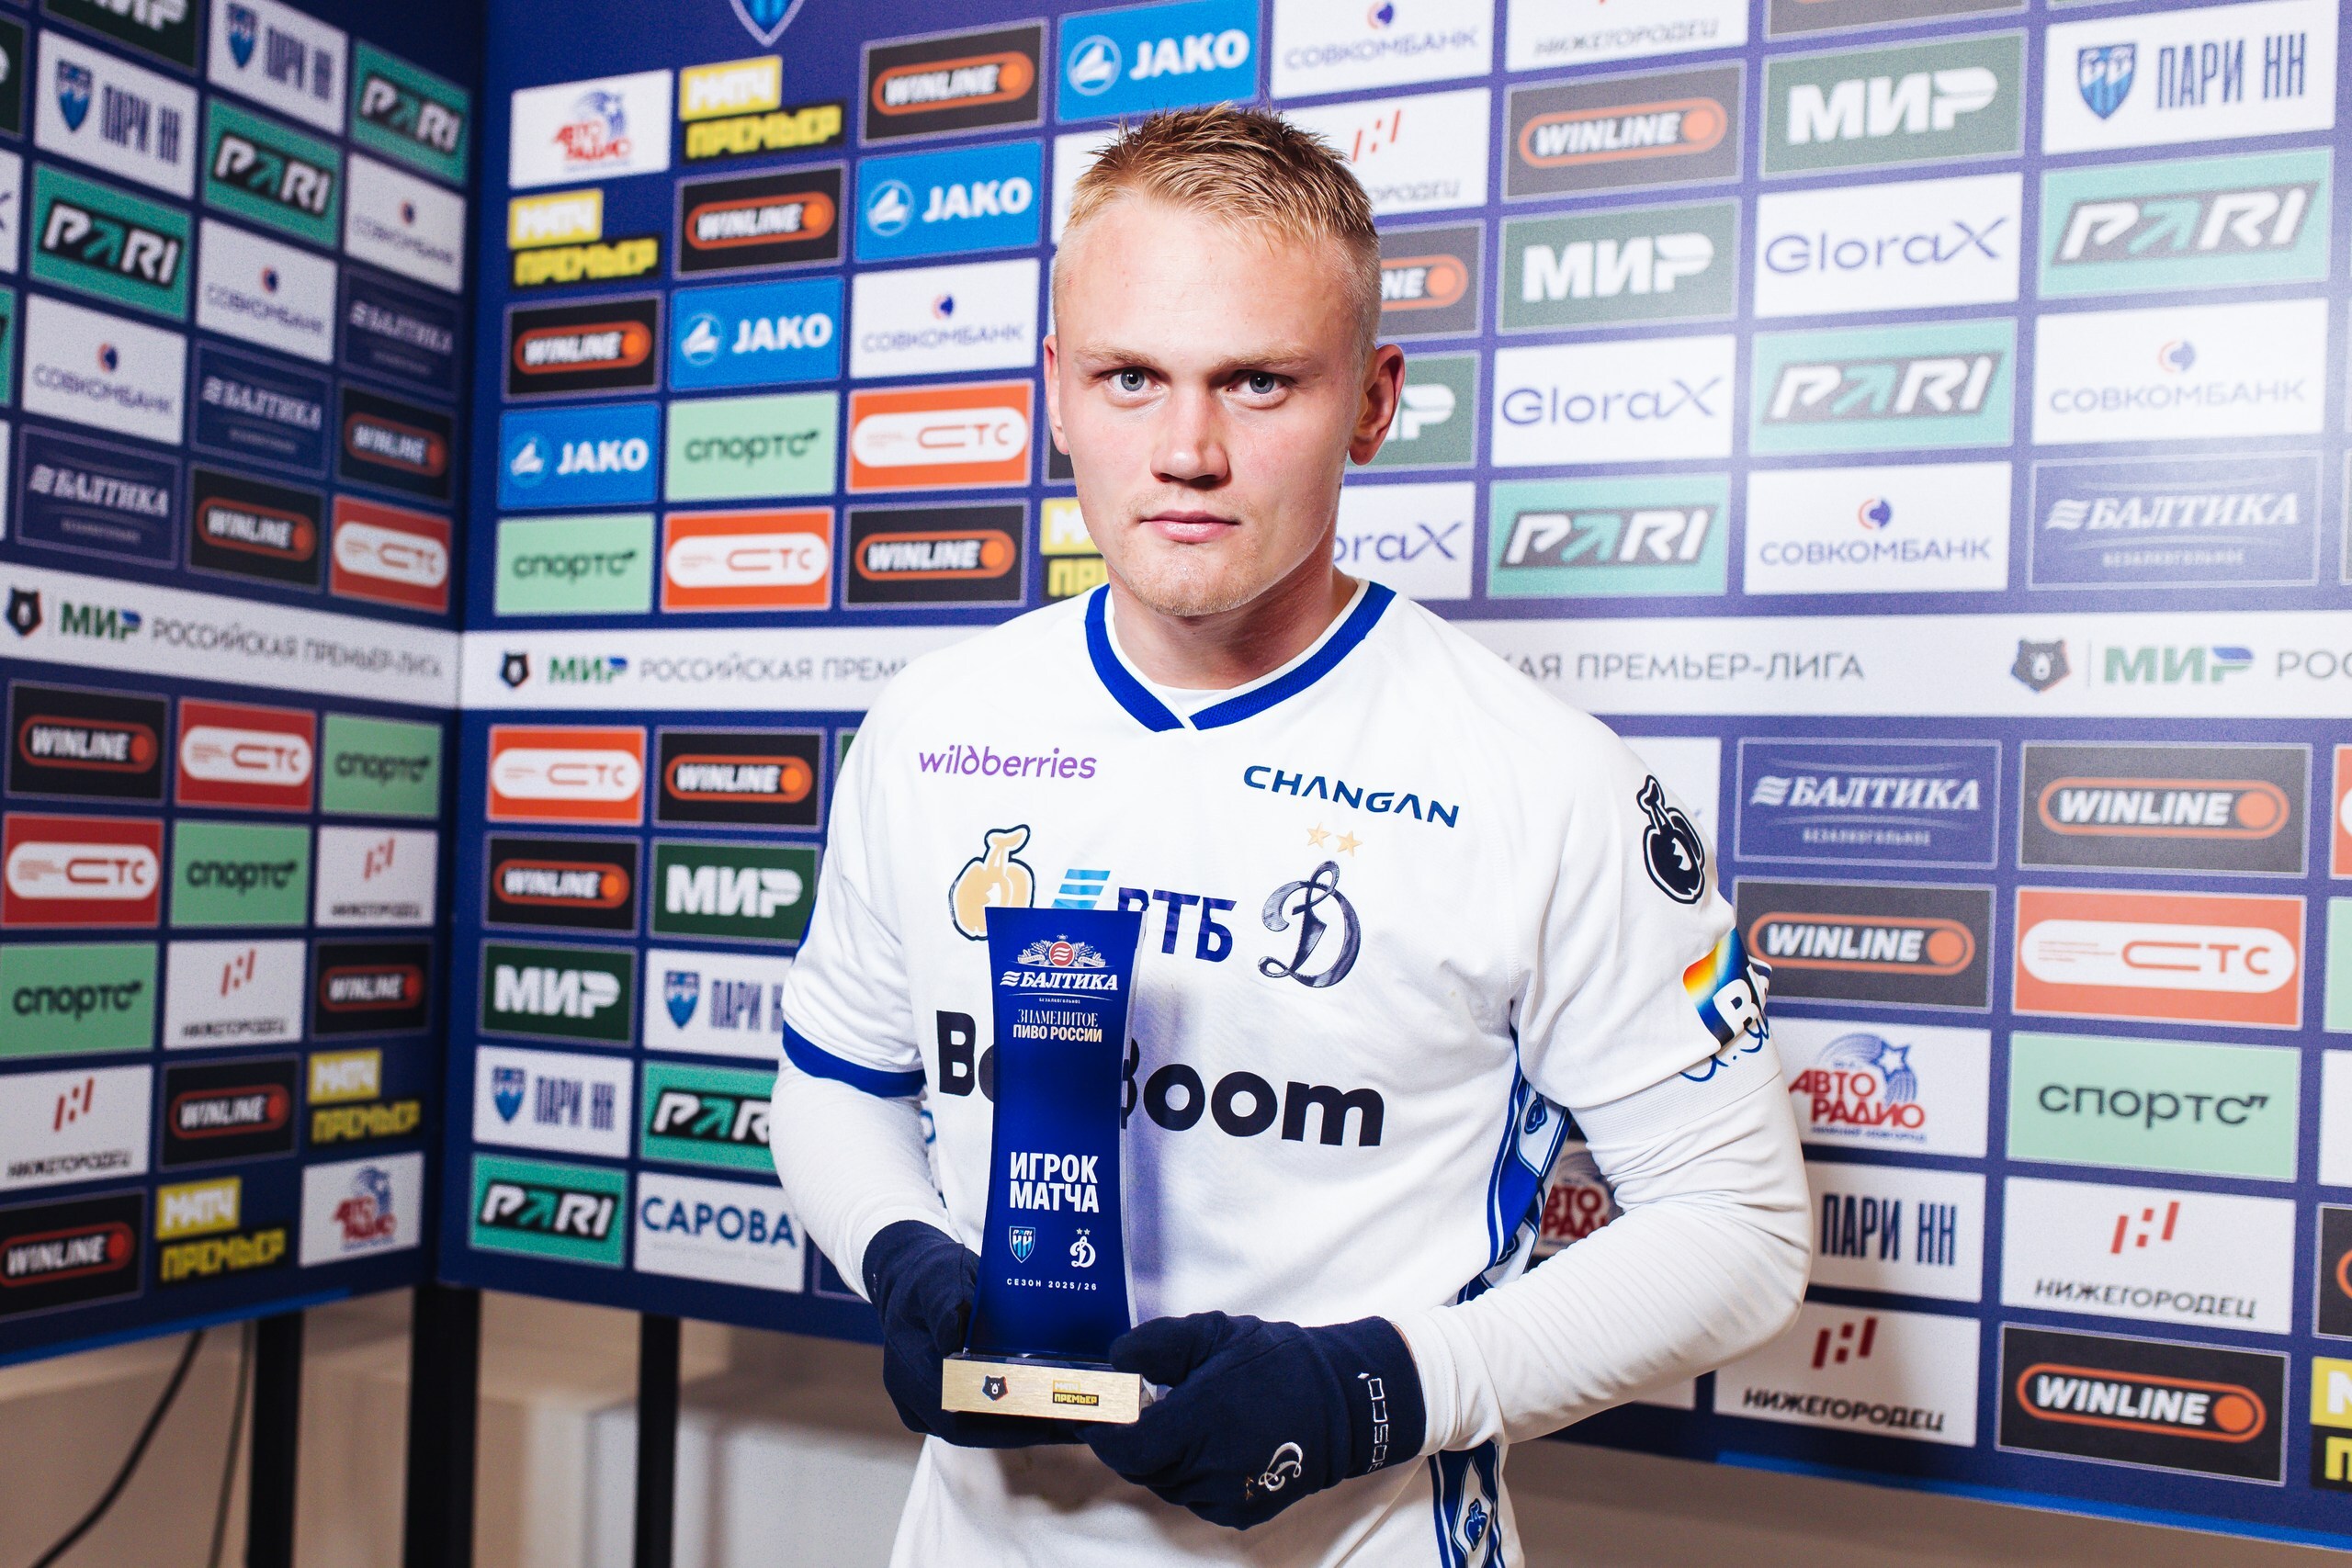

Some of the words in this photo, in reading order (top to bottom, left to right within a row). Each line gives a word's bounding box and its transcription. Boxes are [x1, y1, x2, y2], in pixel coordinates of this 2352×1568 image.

[1129, 30, 1250, 81] JAKO
[1285, 30, 1478, 71] СОВКОМБАНК
[2157, 39, 2244, 109] ПАРИ
[2264, 31, 2306, 100] НН
[1789, 67, 1998, 144] МИР
[1535, 112, 1680, 157] WINLINE
[215, 134, 332, 215] PARI
[922, 177, 1033, 222] JAKO
[698, 203, 803, 241] WINLINE
[2061, 188, 2306, 259] PARI
[42, 202, 180, 286] PARI
[1765, 217, 2008, 274] GloraX
[1523, 232, 1713, 302] МИР
[732, 312, 832, 351] JAKO
[1501, 377, 1722, 425] GloraX
[1772, 356, 1994, 418] PARI
[2051, 381, 2304, 413] СОВКОМБАНК
[557, 438, 649, 475] JAKO
[2087, 493, 2298, 530] БАЛТИКА
[868, 540, 979, 571] WINLINE
[1335, 521, 1464, 563] oraX
[1506, 510, 1708, 564] PARI
[1760, 539, 1991, 565] СОВКОМБАНК
[61, 603, 141, 640] МИР
[549, 656, 627, 683] МИР
[1577, 651, 1864, 682] ПРЕМЬЕР-ЛИГА
[2105, 647, 2255, 683] МИР
[677, 764, 779, 792] WINLINE
[919, 745, 1097, 779] wildberries
[1244, 765, 1459, 828] CHANGAN
[1791, 775, 1980, 811] БАЛТИКА
[2058, 788, 2234, 826] WINLINE
[503, 869, 600, 897] WINLINE
[666, 865, 802, 917] МИР
[1768, 923, 1924, 961] WINLINE
[493, 964, 620, 1017] МИР
[1020, 972, 1118, 990] БАЛТИКА
[1012, 1024, 1047, 1039] ПИВО
[1050, 1026, 1102, 1043] РОССИИ
[1017, 1009, 1098, 1027] ЗНАМЕНИТОЕ
[1789, 1070, 1876, 1097] АВТО
[652, 1094, 770, 1143] PAR
[1811, 1098, 1925, 1129] РАДИО
[1010, 1152, 1099, 1183] ИГРОК
[481, 1185, 613, 1237] PARI
[1010, 1180, 1100, 1213] МАТЧА
[1545, 1185, 1602, 1213] ВТО
[643, 1198, 796, 1247] САРОВА
[1822, 1193, 1902, 1261] ПАРИ
[1917, 1203, 1956, 1266] НН
[7, 1235, 106, 1276] WINLINE
[1006, 1278, 1042, 1287] СЕЗОН
[1048, 1280, 1097, 1291] 2025/26
[2034, 1279, 2257, 1321] НИЖЕГОРОДЕЦ
[1054, 1393, 1097, 1404] ПРЕМЬЕР
[1745, 1388, 1945, 1433] НИЖЕГОРОДЕЦ
[2035, 1375, 2211, 1426] WINLINE
